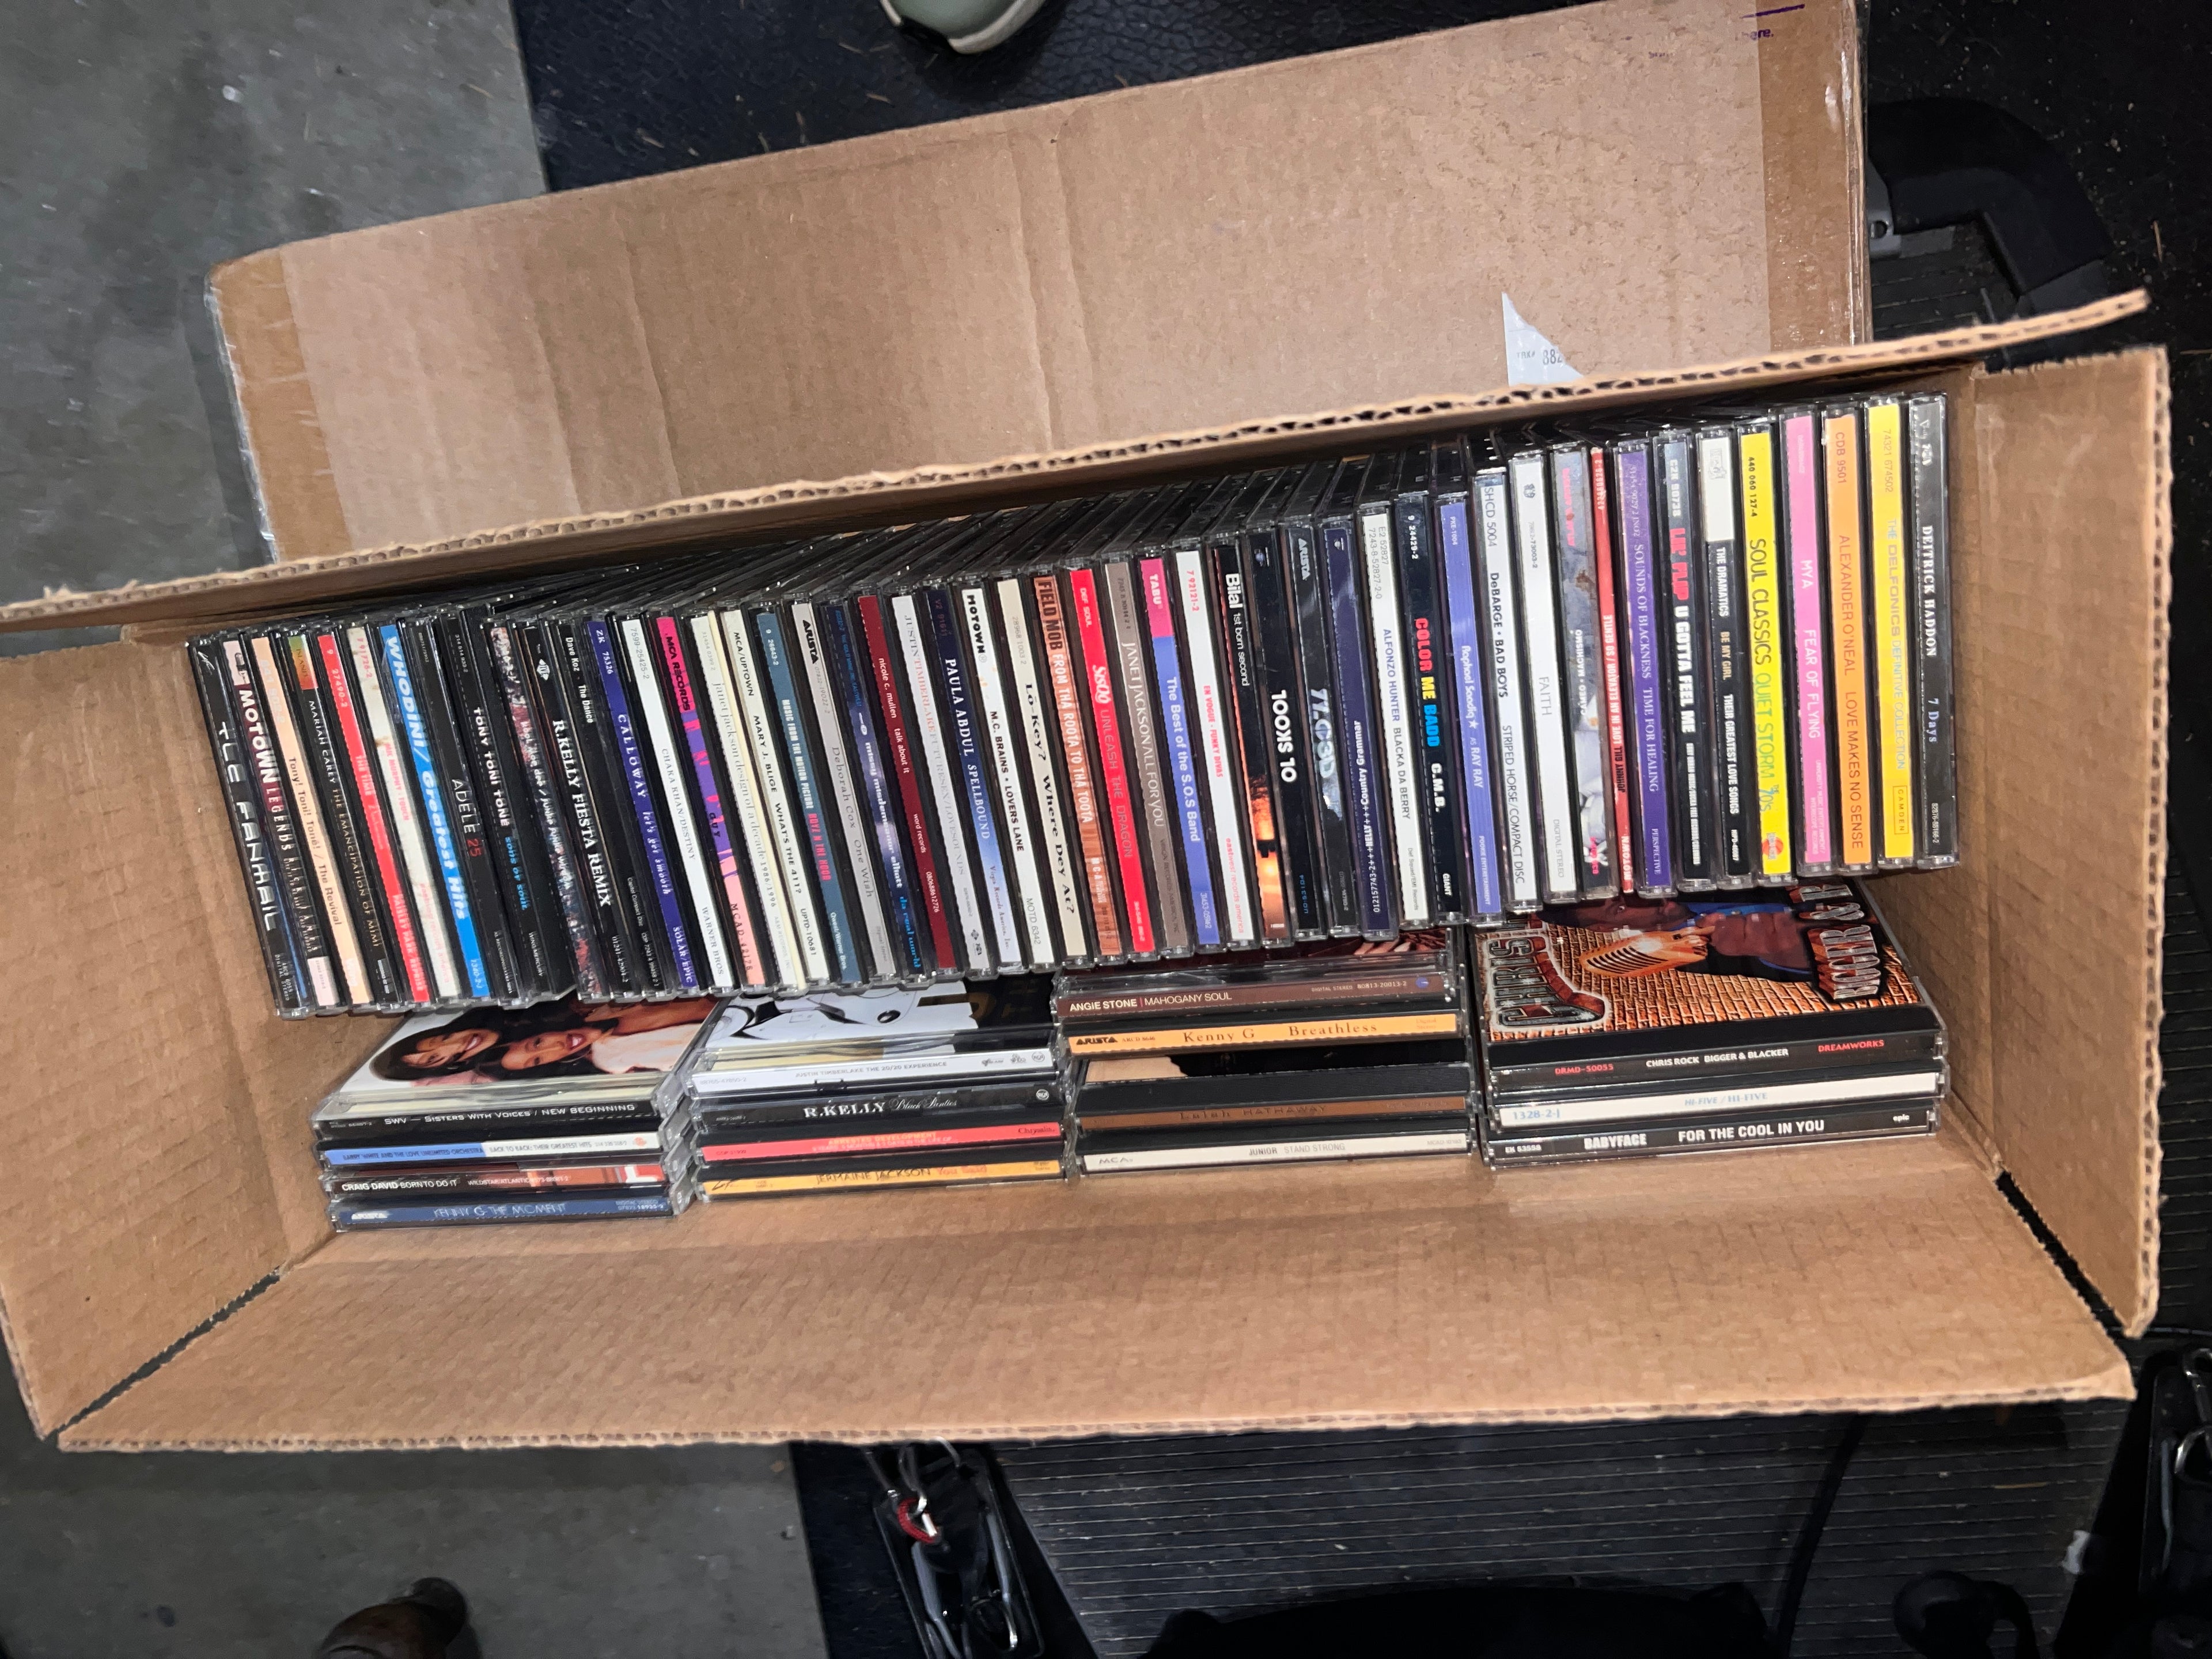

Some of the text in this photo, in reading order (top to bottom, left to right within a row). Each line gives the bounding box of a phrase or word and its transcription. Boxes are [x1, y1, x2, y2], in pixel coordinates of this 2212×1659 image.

[1835, 431, 1846, 483] CDB 9501
[1297, 537, 1310, 580] ARISTA
[1800, 559, 1813, 588] MYA
[1838, 534, 1853, 620] ALEXANDER
[1921, 525, 1936, 656] DEITRICK HADDON
[565, 636, 577, 656] Dave
[802, 618, 819, 664] ARISTA
[967, 594, 986, 654] MOTOWN
[1224, 572, 1250, 687] Bilal second
[1488, 572, 1508, 698] DeBARGE BAD BOYS
[733, 631, 754, 696] MCA/UPTOWN
[904, 614, 935, 733] JUSTIN TIMBERLAKE
[1121, 641, 1141, 682] JANET
[1574, 629, 1585, 676] MACHISMO
[1634, 544, 1658, 792] SOUNDS OF BLACKNESS TIME FOR HEALING
[1675, 605, 1695, 733] U GOTTA FEEL ME
[1748, 538, 1775, 779] SOUL CLASSICS QUIET STORM
[1888, 544, 1906, 769] DELFONICS COLLECTION
[671, 661, 691, 711] RECORDS
[1037, 580, 1093, 823] FIELD MOB FROM THA ROOTA TO TOOTA
[1414, 617, 1440, 747] COLOR ME BADD
[1538, 675, 1551, 715] FAITH
[1603, 614, 1622, 744] LOVE GENTLE
[1715, 546, 1739, 815] THE DRAMATICS GIRL THEIR GREATEST LOVE SONGS
[1804, 629, 1820, 738] FEAR OF FLYING
[472, 707, 489, 747] TONY
[720, 713, 741, 758] jackson
[781, 698, 794, 722] MUSIC
[1128, 683, 1151, 745] JACKSON
[1270, 689, 1297, 782] OL SKOOL
[1382, 628, 1410, 820] ALFONZO HUNTER BLACKA BERRY
[216, 721, 239, 783] TLC
[616, 713, 646, 800] CALLOWAY
[862, 741, 878, 777] missy
[897, 744, 908, 766] about
[944, 657, 990, 839] PAULA ABDUL SPELLBOUND
[1166, 677, 1200, 842] The Best the Band
[1205, 697, 1223, 778] VOGUE DIVAS
[1353, 719, 1365, 766] Grammar
[238, 687, 291, 851] MOTOWN LEGENDS
[287, 757, 303, 787] Tony!
[361, 775, 372, 796] TIME
[388, 759, 402, 790] MURPHY
[661, 748, 676, 783] CHAKA
[753, 714, 795, 866] MARY BLIGE THE
[1430, 762, 1445, 812] C.M.B.
[1470, 747, 1483, 789] RAY RAY
[1845, 691, 1863, 849] LOVE MAKES NO SENSE
[308, 700, 366, 896] MARIAH CAREY EMANCIPATION
[451, 777, 482, 858] ADELE 25
[552, 718, 611, 907] R.KELLY FIESTA REMIX
[994, 735, 1024, 853] BRAINS LOVERS LANE
[1501, 725, 1524, 884] STRIPED HORSE/COMPACT DISC
[421, 770, 468, 920] Greatest Hits
[912, 813, 922, 830] word
[1042, 774, 1067, 878] Where Dey
[1116, 804, 1133, 858] DRAGON
[236, 800, 275, 931] FANMAIL
[324, 887, 342, 925] Revival
[701, 906, 717, 947] WARNER
[1489, 935, 1603, 1027] CHRIS
[1819, 924, 1882, 1000] BIGGER
[1069, 991, 1232, 1012] ANGIE STONE MAHOGANY SOUL
[1183, 1028, 1234, 1043] Kenny
[1289, 1020, 1377, 1037] Breathless
[1817, 1039, 1884, 1052] DREAMWORKS
[904, 1061, 947, 1070] EXPERIENCE
[1645, 1048, 1789, 1068] CHRIS ROCK BIGGER BLACKER
[384, 1117, 406, 1125] SWV
[541, 1104, 635, 1116] NEW BEGINNING
[802, 1101, 887, 1118] R.KELLY
[1728, 1092, 1768, 1103] HI-FIVE
[1312, 1143, 1346, 1152] STRONG
[1583, 1133, 1647, 1150] BABYFACE
[1678, 1119, 1824, 1142] FOR THE COOL IN YOU
[341, 1183, 369, 1191] CRAIG
[816, 1171, 872, 1184] JERMAINE
